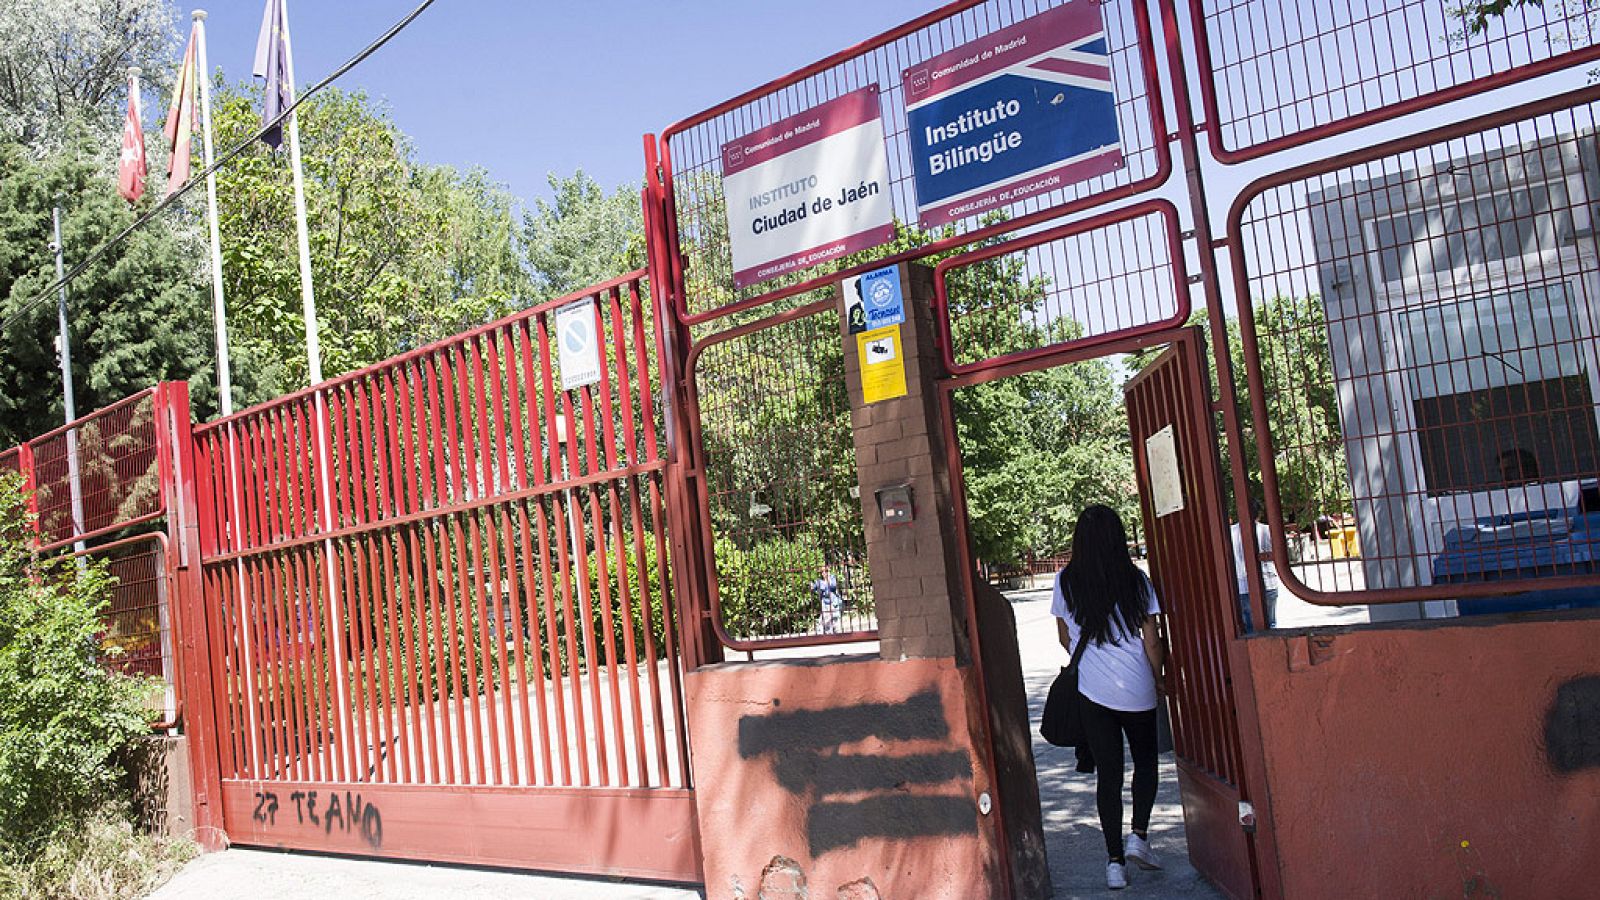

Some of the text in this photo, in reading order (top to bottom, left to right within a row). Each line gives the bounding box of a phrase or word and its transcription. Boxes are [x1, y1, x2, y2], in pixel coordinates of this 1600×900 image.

[930, 35, 1027, 81] Comunidad de Madrid
[744, 119, 821, 155] Comunidad de Madrid
[924, 99, 1021, 146] Instituto
[929, 130, 1023, 176] Bilingüe
[750, 174, 819, 210] INSTITUTO
[752, 180, 880, 235] Ciudad de Jaén
[948, 175, 1061, 217] CONSEJERÍA DE EDUCACIÓN
[757, 243, 847, 278] CONSEJERÍA DE EDUCACIÓN
[865, 268, 893, 281] ALARMA
[253, 790, 279, 826] 27
[290, 790, 320, 826] TE
